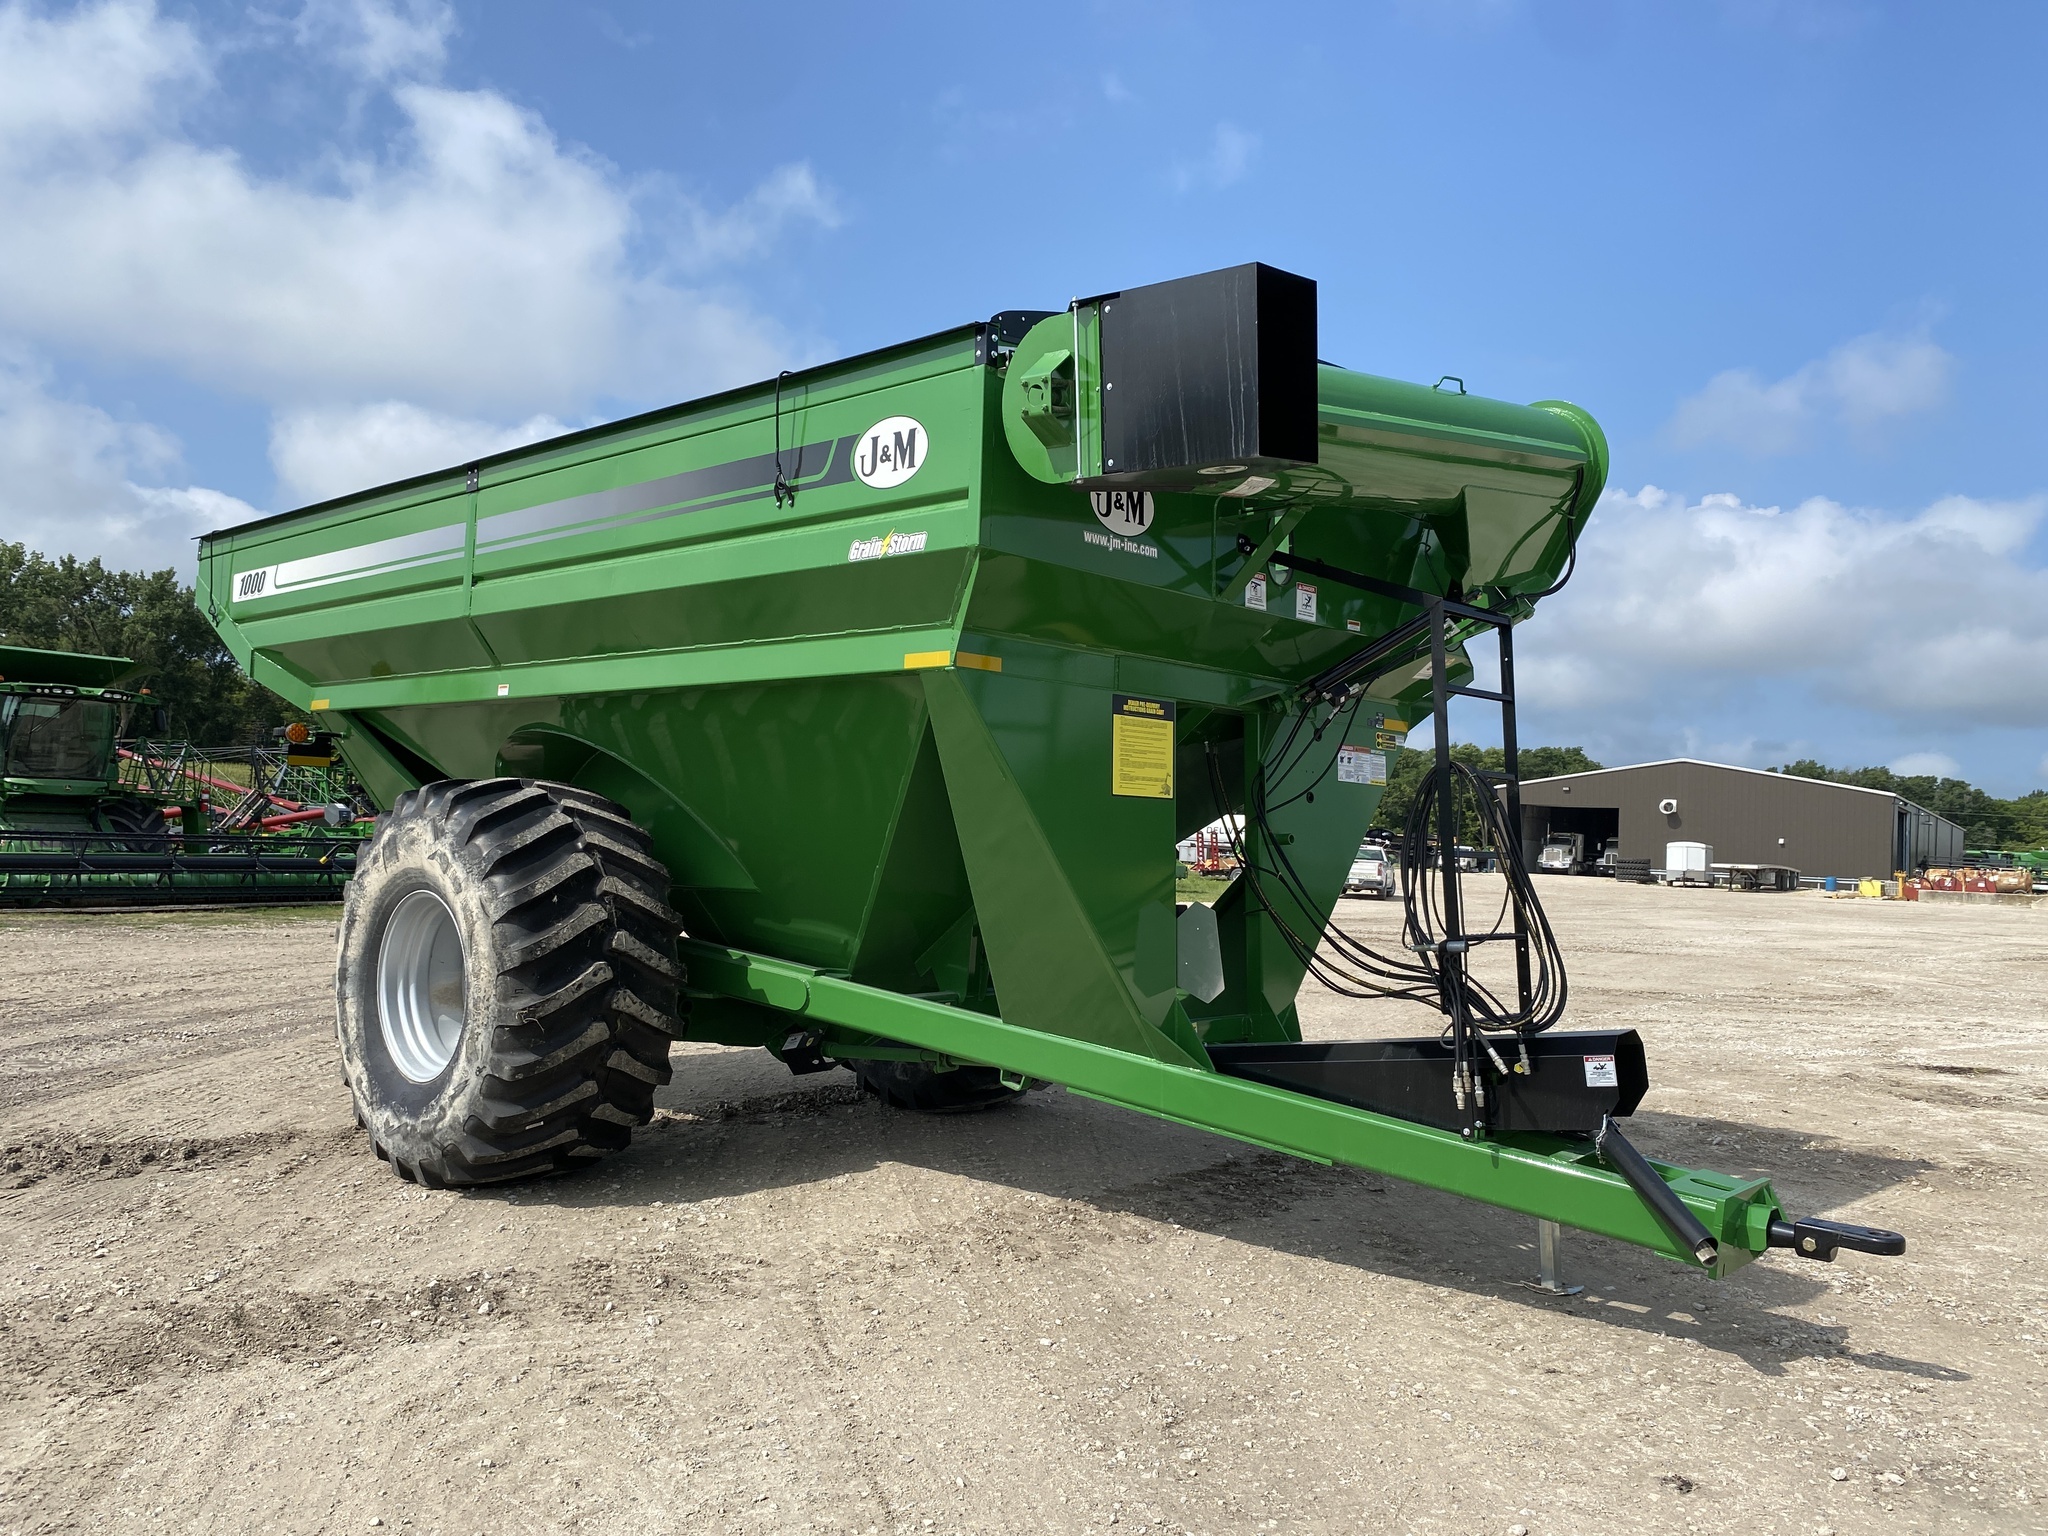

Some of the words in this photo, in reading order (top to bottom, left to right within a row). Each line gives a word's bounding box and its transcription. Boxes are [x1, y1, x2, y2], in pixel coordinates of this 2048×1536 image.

[859, 427, 918, 478] J&M
[1094, 491, 1146, 527] J&M
[848, 537, 884, 562] Grain
[887, 531, 928, 556] Storm
[1082, 530, 1158, 559] www.jm-inc.com
[239, 570, 267, 597] 1000
